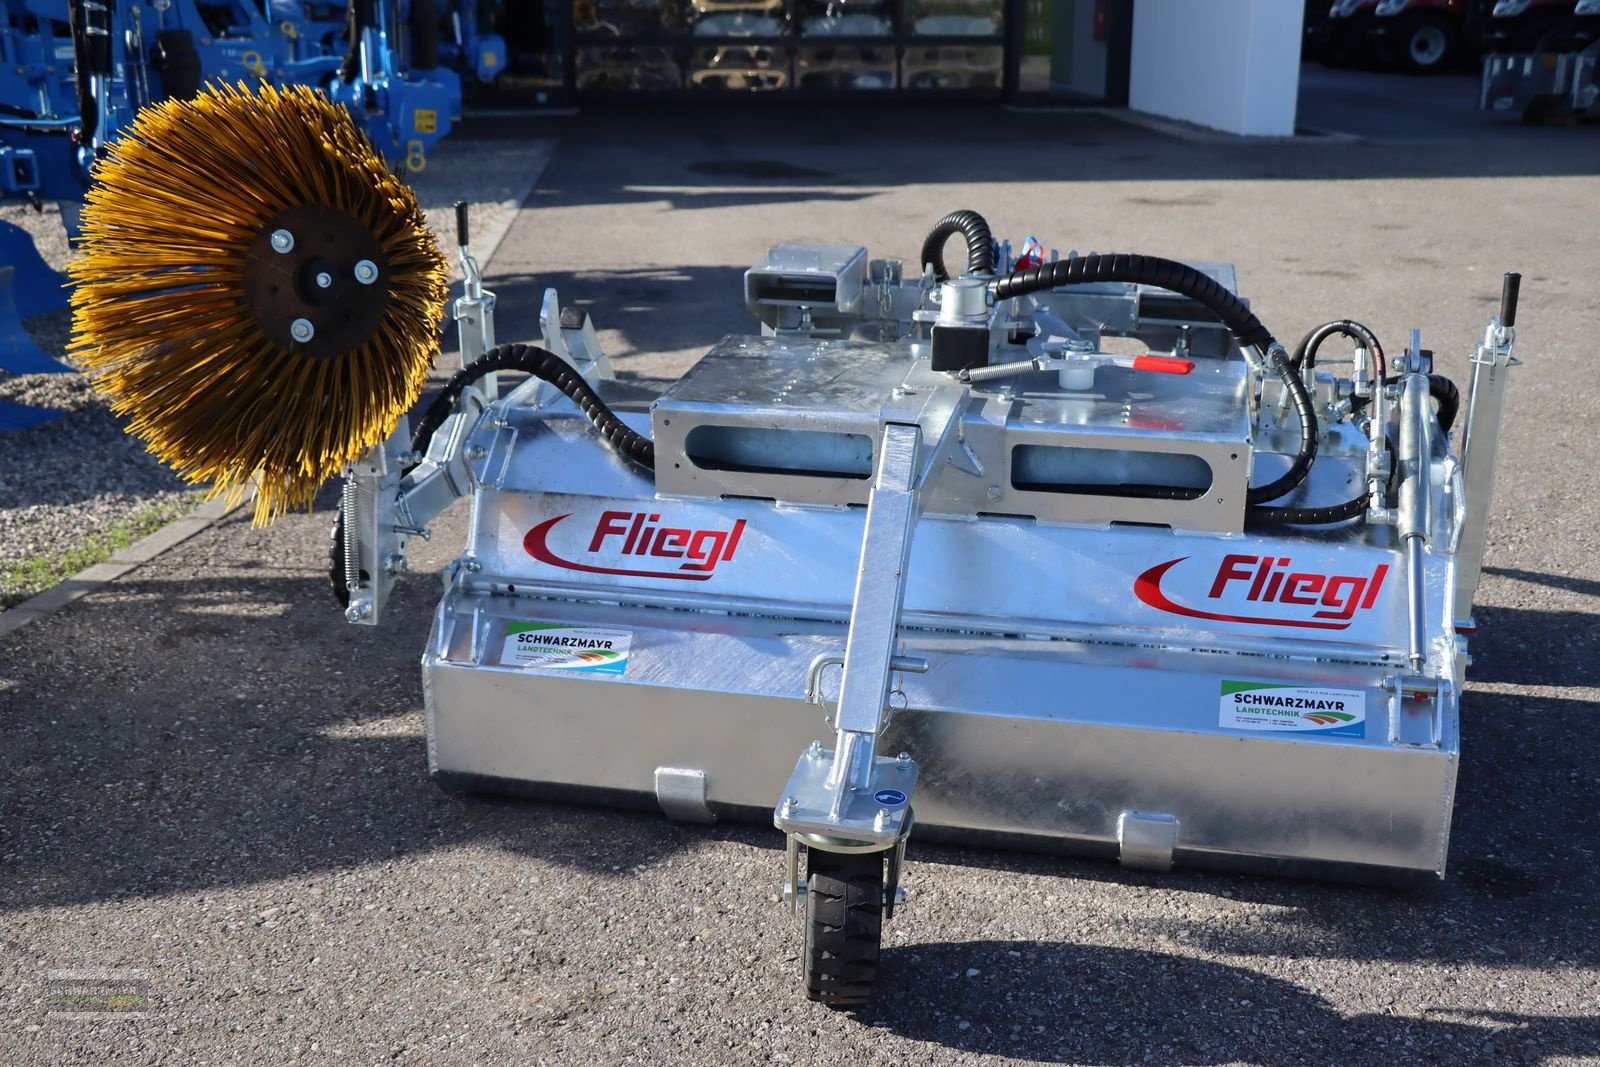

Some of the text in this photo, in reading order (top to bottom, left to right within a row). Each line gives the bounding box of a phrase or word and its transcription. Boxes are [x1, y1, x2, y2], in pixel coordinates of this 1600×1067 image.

[588, 511, 747, 571] Fliegl
[1208, 554, 1389, 620] Fliegl
[517, 633, 613, 650] SCHWARZMAYR
[517, 645, 573, 655] LANDTECHNIK
[1234, 693, 1345, 711] SCHWARZMAYR
[1236, 706, 1300, 717] LANDTECHNIK
